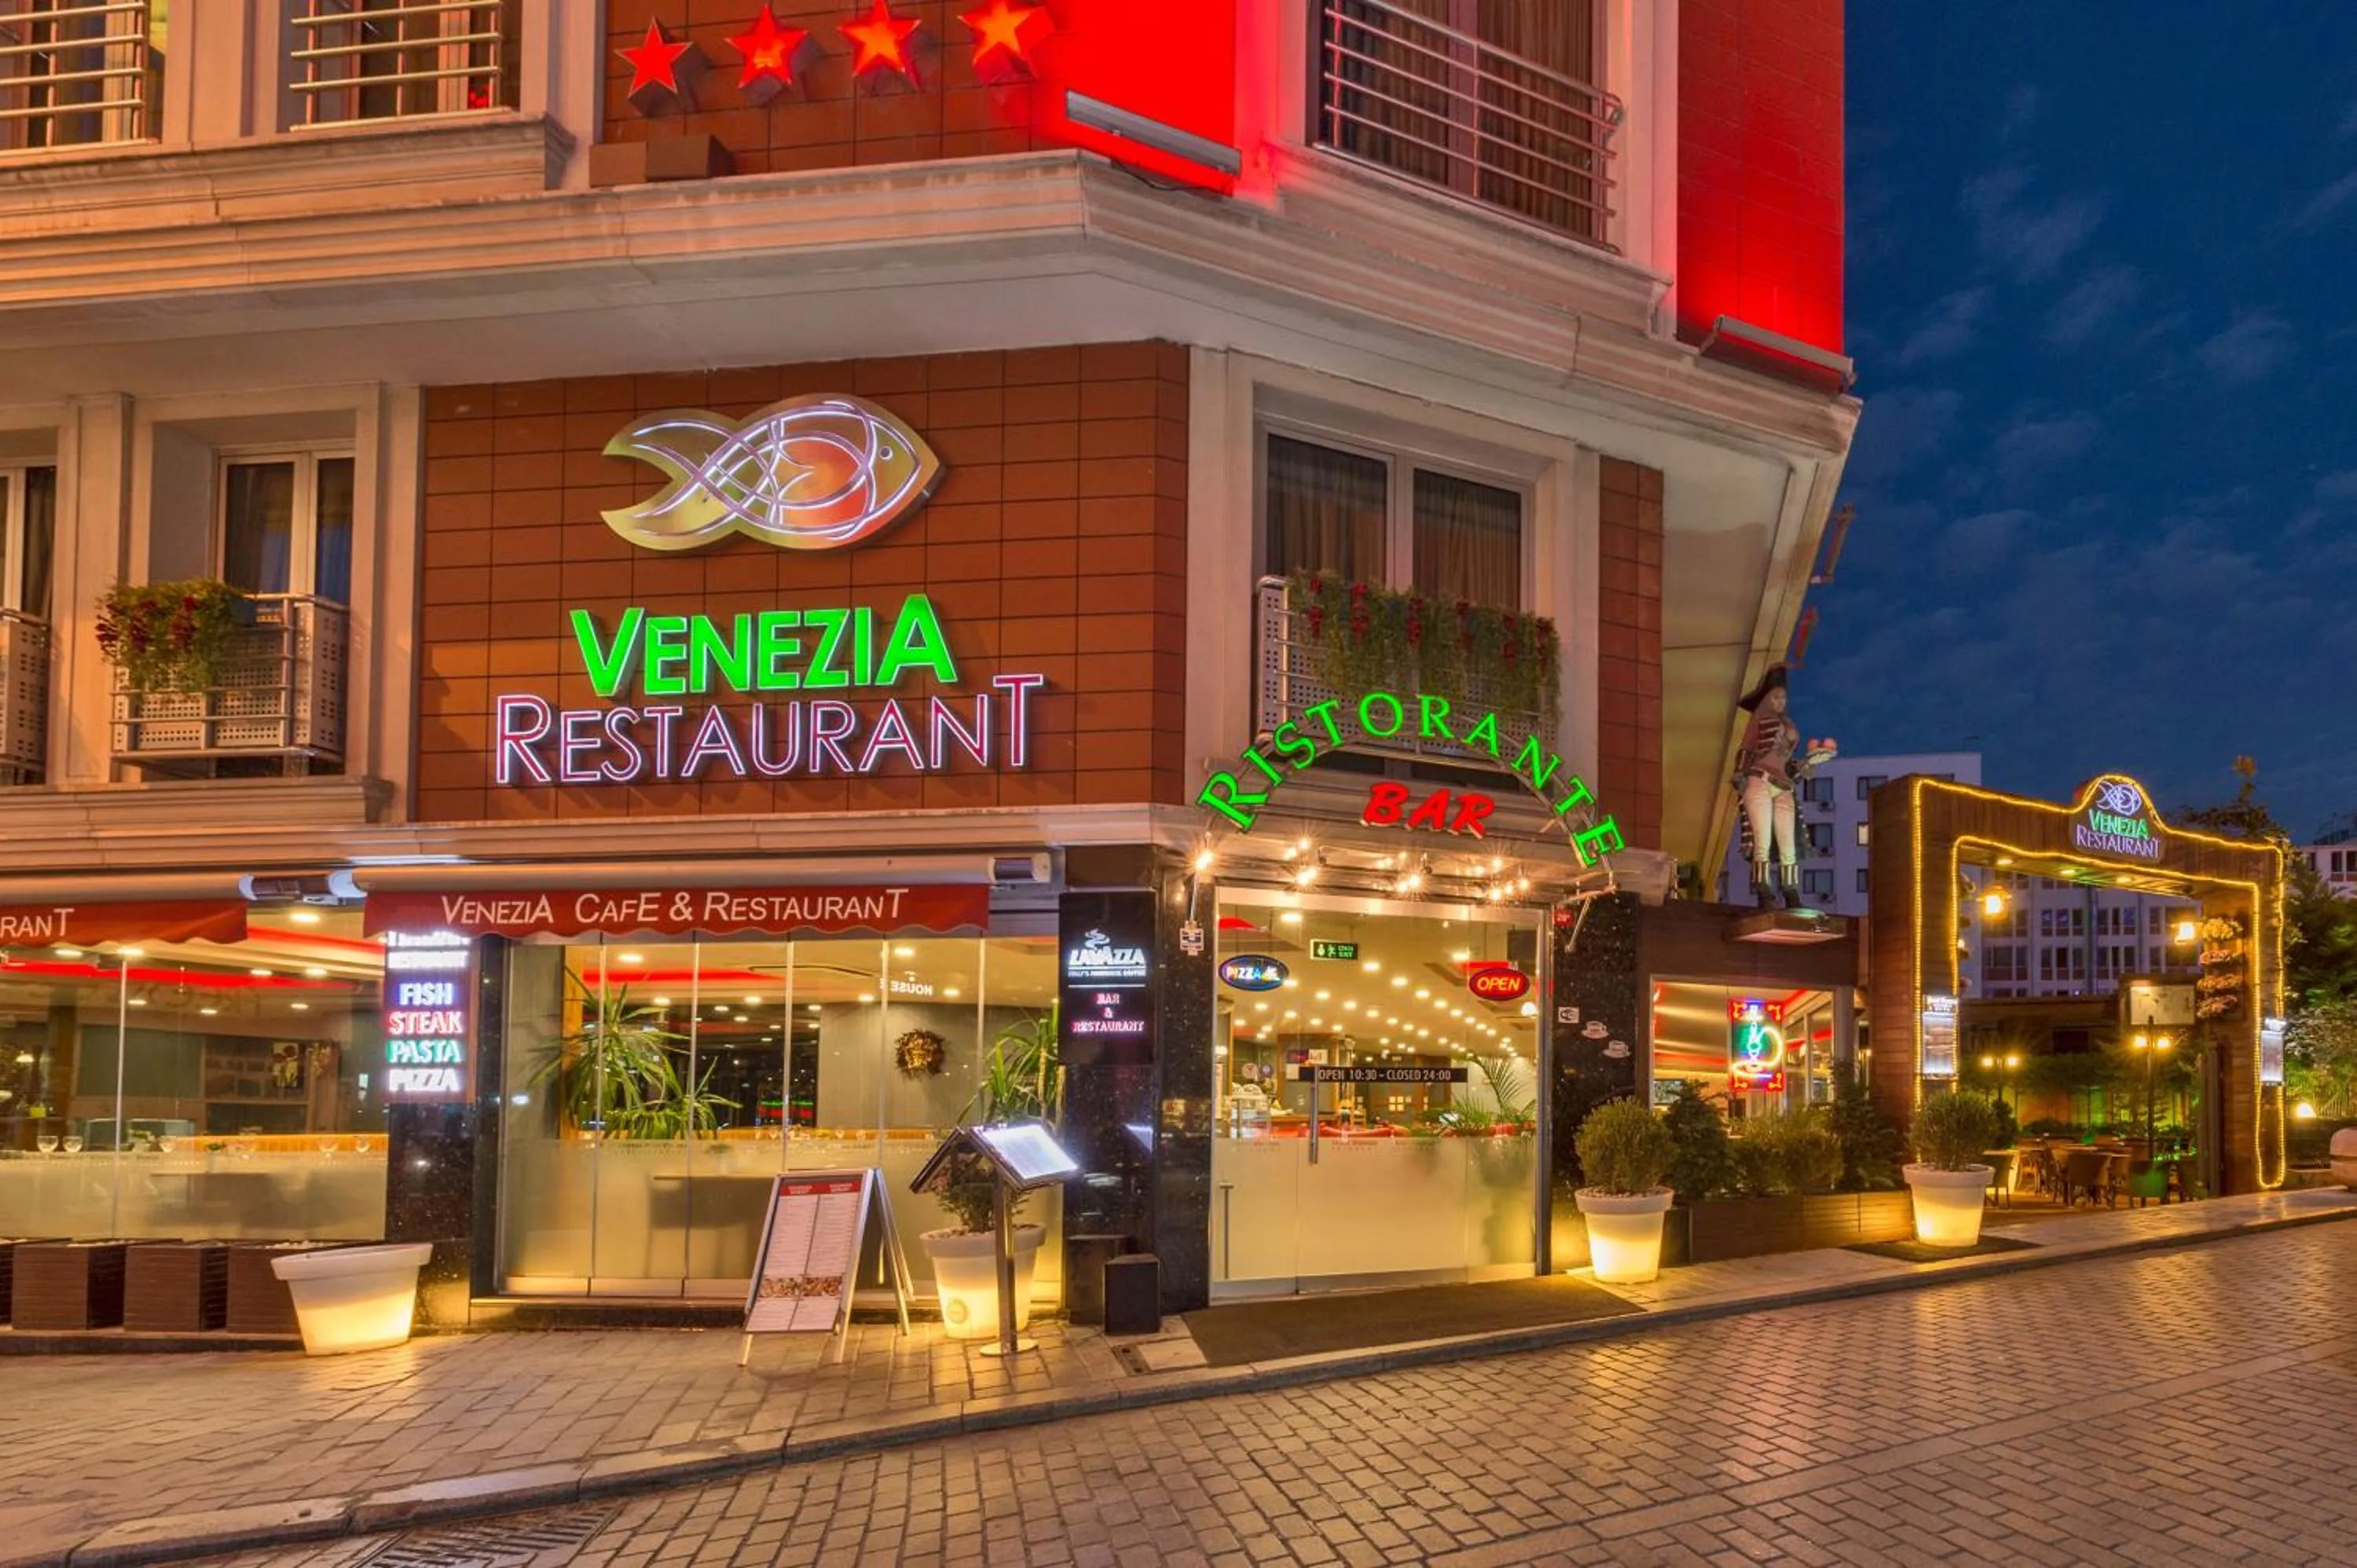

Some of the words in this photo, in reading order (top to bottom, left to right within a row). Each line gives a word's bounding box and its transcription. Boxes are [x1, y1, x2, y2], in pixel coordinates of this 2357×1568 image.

[569, 593, 958, 698] VENEZIA
[495, 673, 1044, 784] RESTAURANT
[1196, 691, 1626, 866] RISTORANTE
[1362, 781, 1495, 837] BAR
[2088, 808, 2150, 841] VENEZIA
[2076, 822, 2161, 859] RESTAURANT
[441, 893, 554, 925] VENEZIA
[574, 892, 662, 923] CAFE
[669, 891, 694, 921] &
[703, 888, 909, 921] RESTAURANT
[1069, 945, 1146, 966] LAVAZZA
[1226, 966, 1262, 981] PIZZA
[1477, 976, 1521, 991] OPEN
[399, 982, 454, 1006] FISH
[388, 1011, 464, 1035] STEAK
[387, 1039, 462, 1063] PASTA
[388, 1068, 461, 1092] PIZZA
[1318, 1068, 1345, 1080] OPEN
[1349, 1068, 1376, 1081] 10:30
[1386, 1068, 1421, 1081] CLOSED
[1423, 1068, 1452, 1081] 24:00
